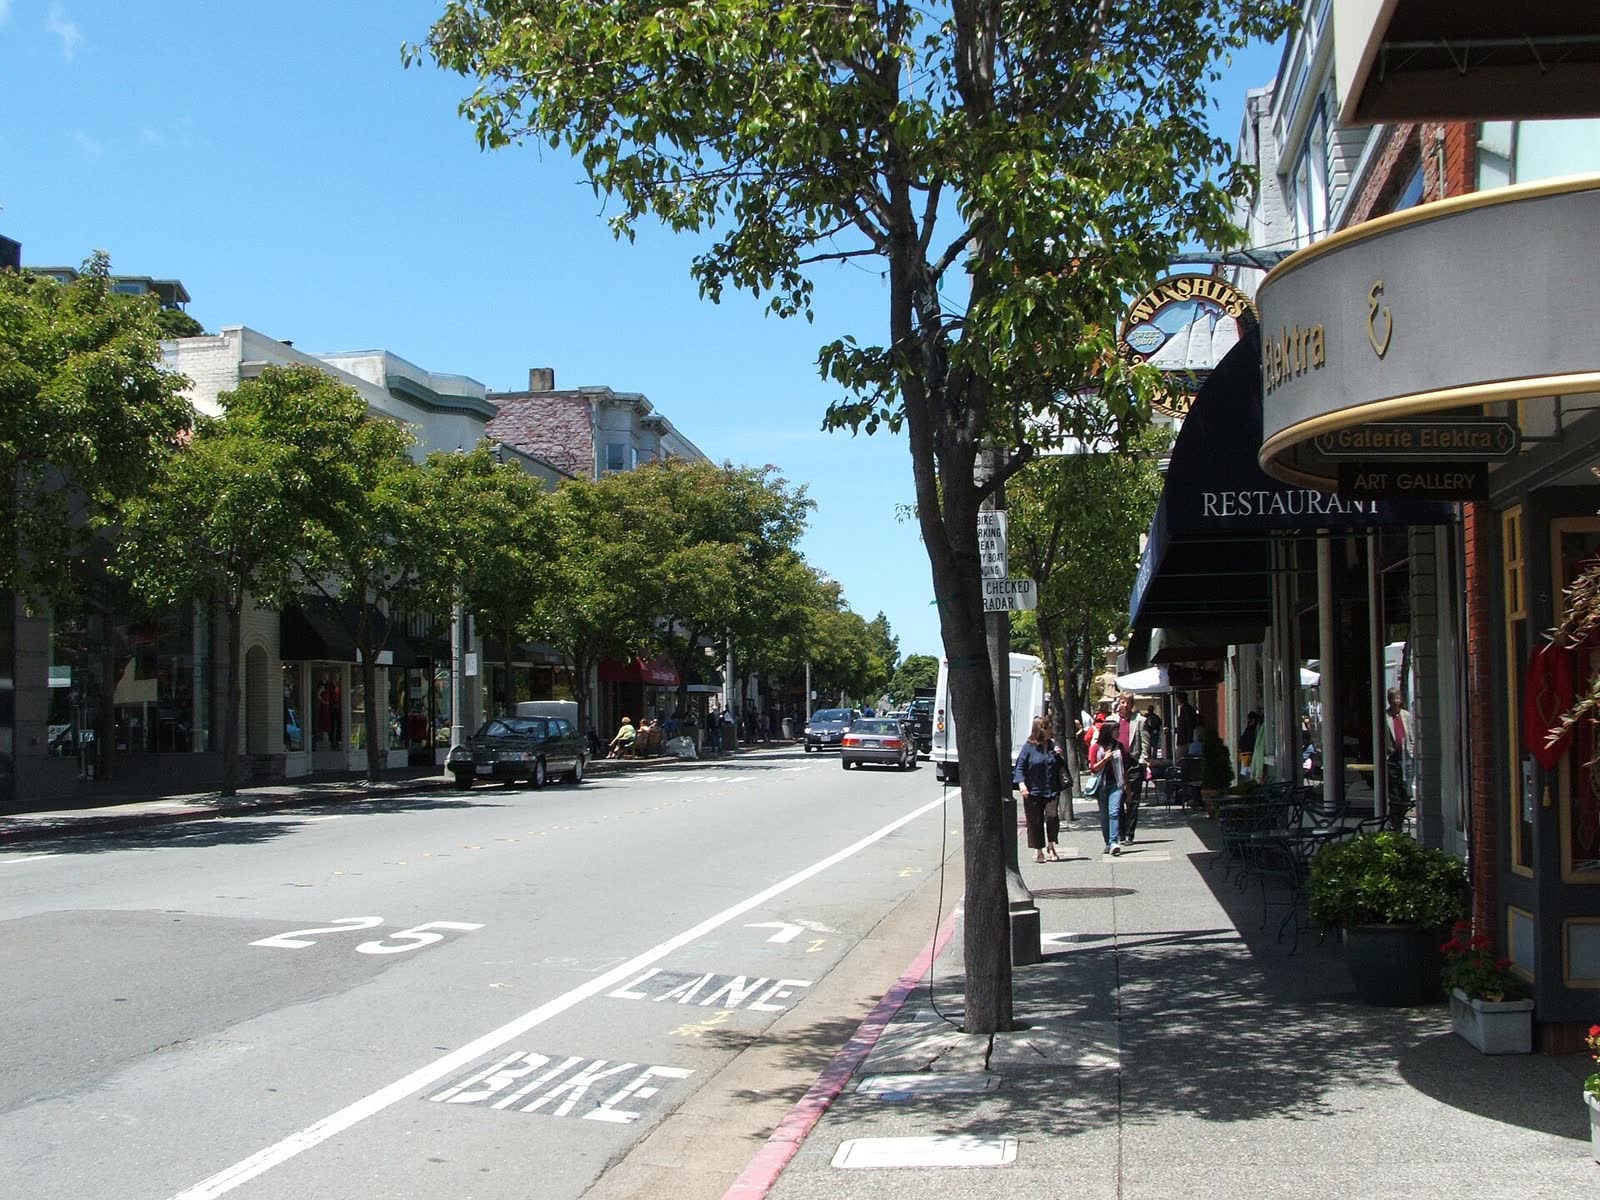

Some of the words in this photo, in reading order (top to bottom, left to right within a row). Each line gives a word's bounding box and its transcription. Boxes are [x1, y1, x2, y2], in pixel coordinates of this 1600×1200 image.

[1263, 324, 1326, 393] Elektra
[1339, 429, 1412, 448] Galerie
[1420, 428, 1491, 447] Elektra
[1354, 473, 1388, 490] ART
[1396, 473, 1477, 490] GALLERY
[978, 528, 1001, 538] RKING
[981, 541, 995, 551] EAR
[986, 581, 1030, 595] CHECKED
[607, 967, 813, 1012] LANE
[428, 1050, 695, 1125] BIKE
